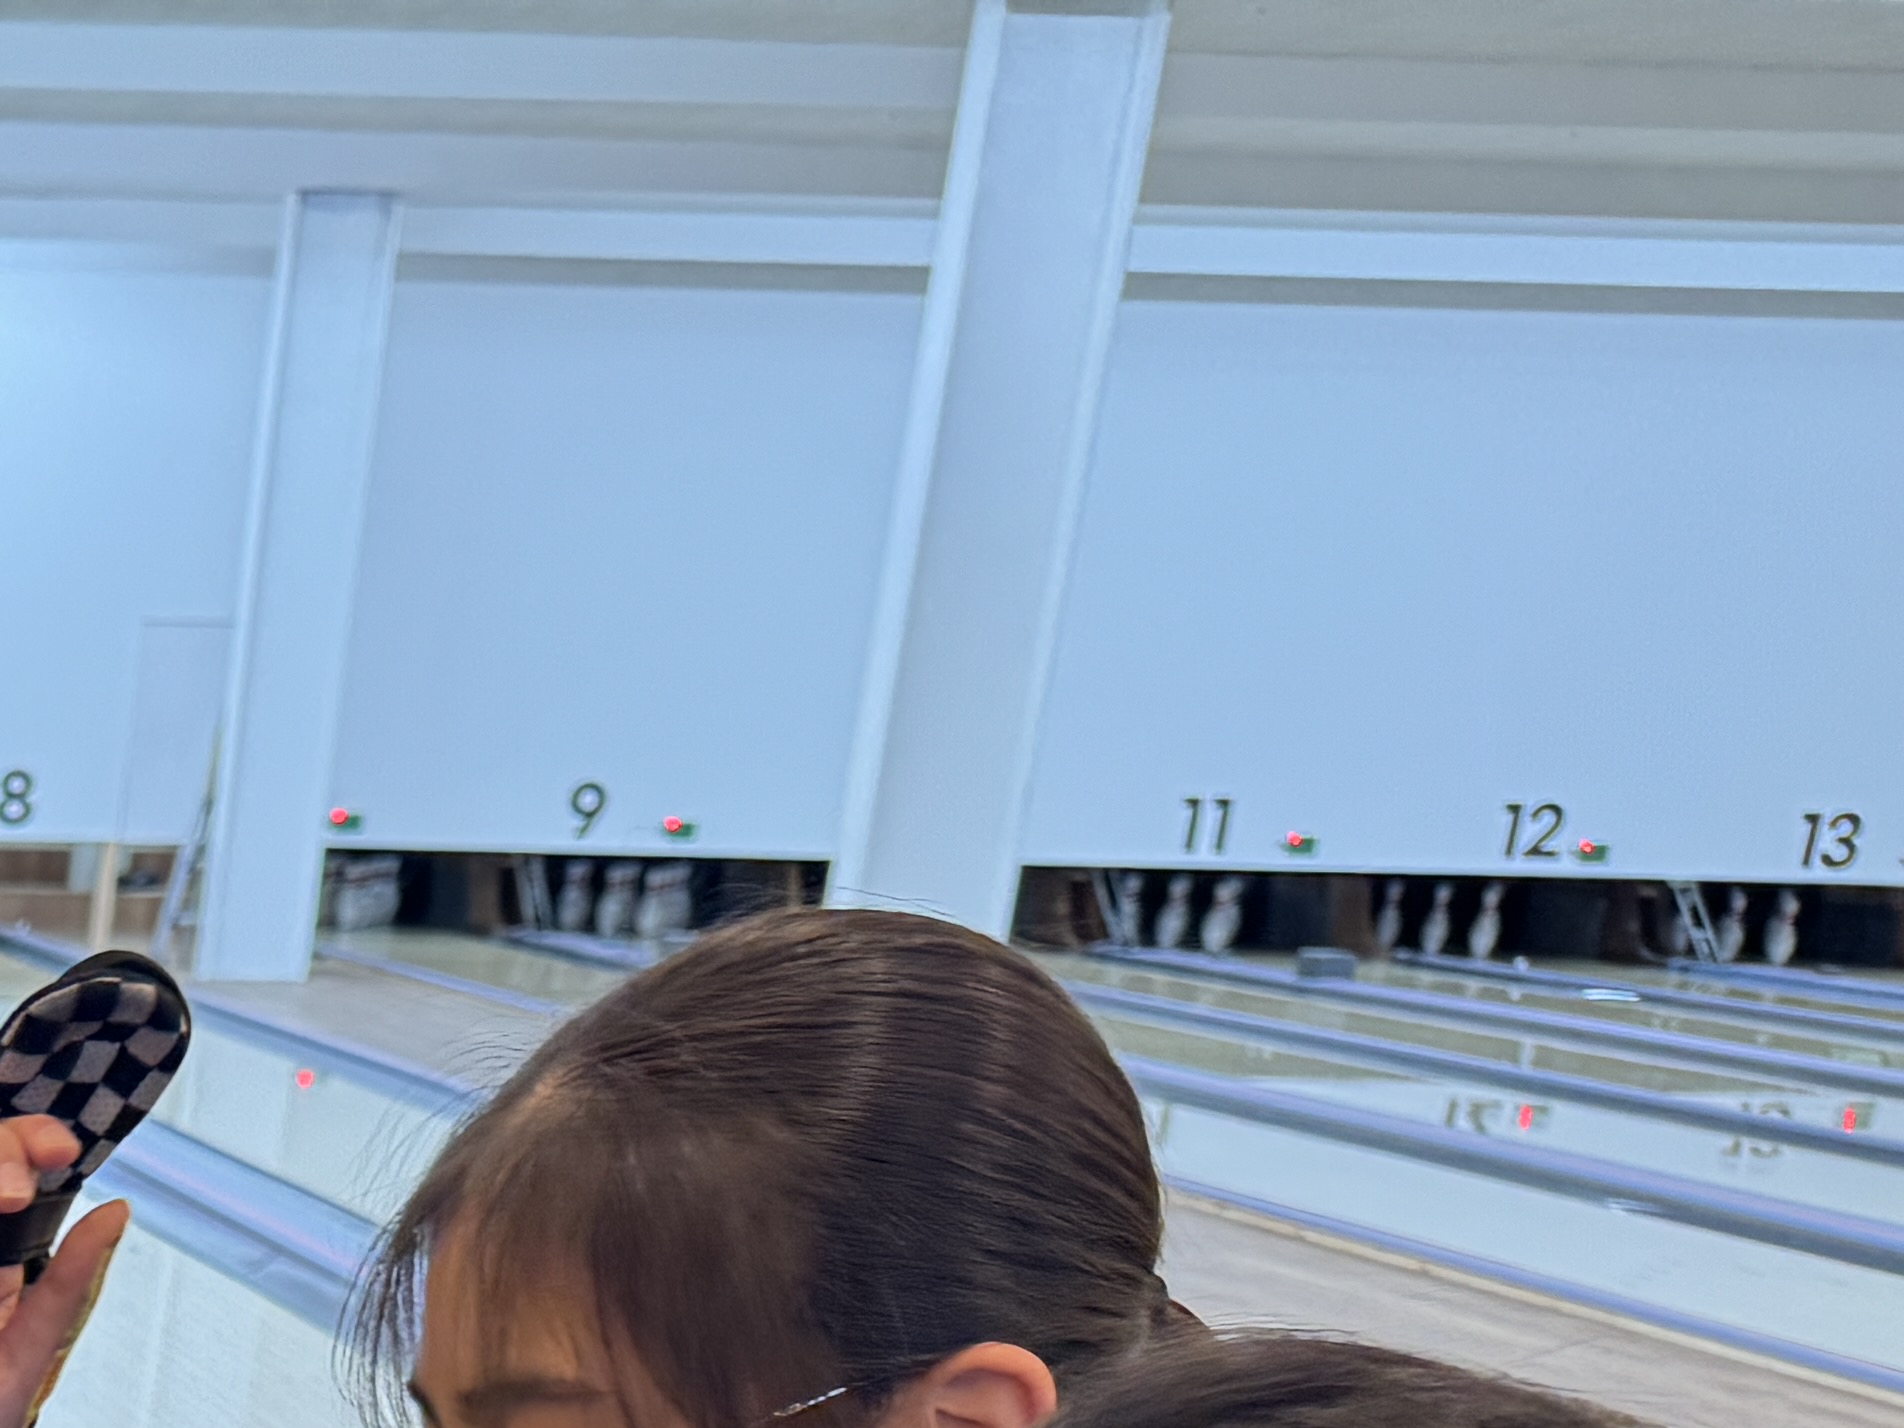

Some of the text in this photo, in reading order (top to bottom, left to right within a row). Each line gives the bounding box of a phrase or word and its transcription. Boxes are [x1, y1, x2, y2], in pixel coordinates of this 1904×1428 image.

[570, 782, 605, 838] 9
[1183, 798, 1232, 855] 11
[1505, 803, 1565, 859] 12
[1802, 812, 1862, 868] 13
